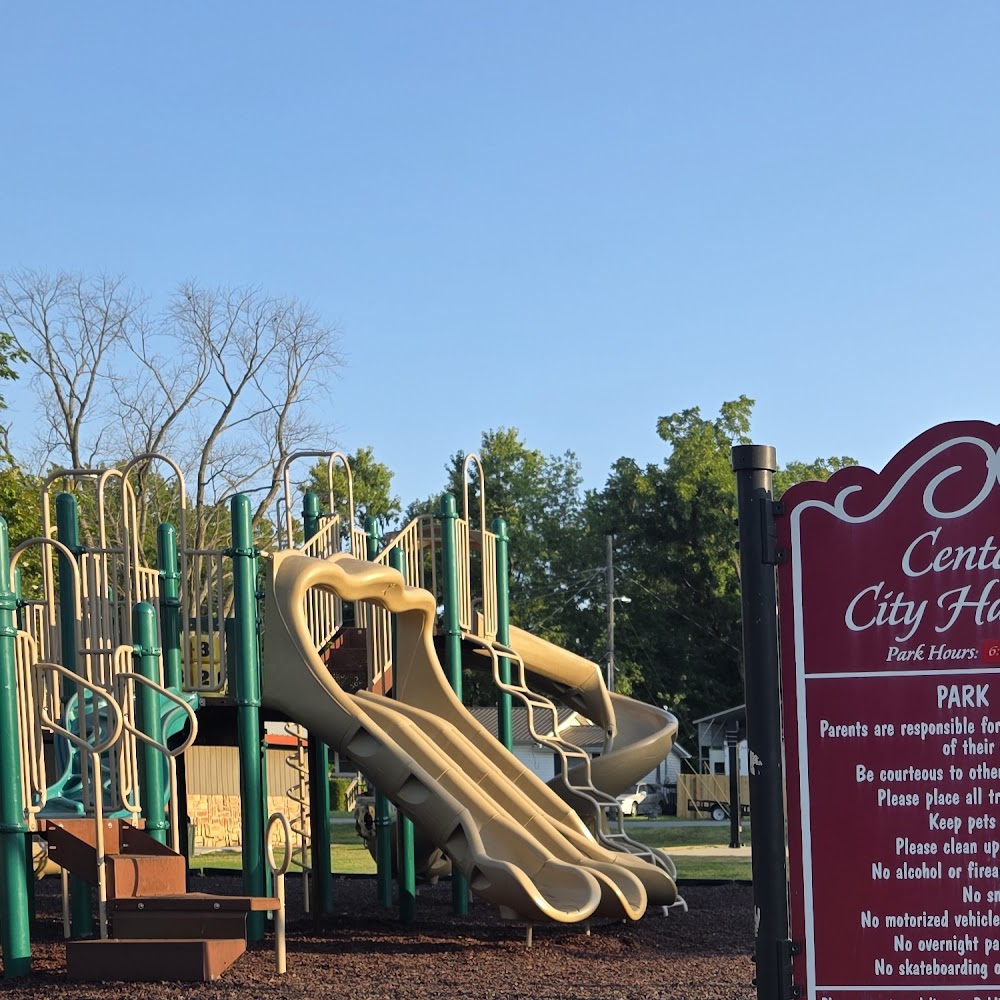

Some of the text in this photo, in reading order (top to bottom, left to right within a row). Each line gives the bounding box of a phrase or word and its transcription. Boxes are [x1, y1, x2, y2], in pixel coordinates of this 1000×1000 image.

[845, 581, 928, 642] City
[886, 643, 925, 661] Park
[928, 644, 979, 660] Hours:
[937, 684, 989, 709] PARK
[820, 720, 868, 738] Parents
[874, 724, 894, 737] are
[901, 716, 975, 740] responsible
[981, 716, 1000, 734] for
[942, 738, 958, 756] of
[962, 737, 995, 755] their
[856, 764, 874, 783] Be
[880, 766, 943, 782] courteous
[949, 765, 963, 781] to
[878, 788, 919, 807] Please
[926, 788, 960, 811] place
[966, 786, 982, 805] all
[929, 812, 962, 835] Keep
[968, 814, 996, 834] pets
[896, 837, 938, 855] Please
[943, 837, 977, 855] clean
[984, 840, 1000, 859] up
[872, 862, 890, 880] No
[896, 861, 942, 879] alcohol
[948, 866, 962, 879] or
[963, 885, 981, 903] No
[861, 910, 879, 928] No
[885, 910, 948, 928] motorized
[894, 934, 912, 952] No
[918, 934, 979, 956] overnight
[875, 958, 893, 975] No
[899, 958, 988, 980] skateboarding
